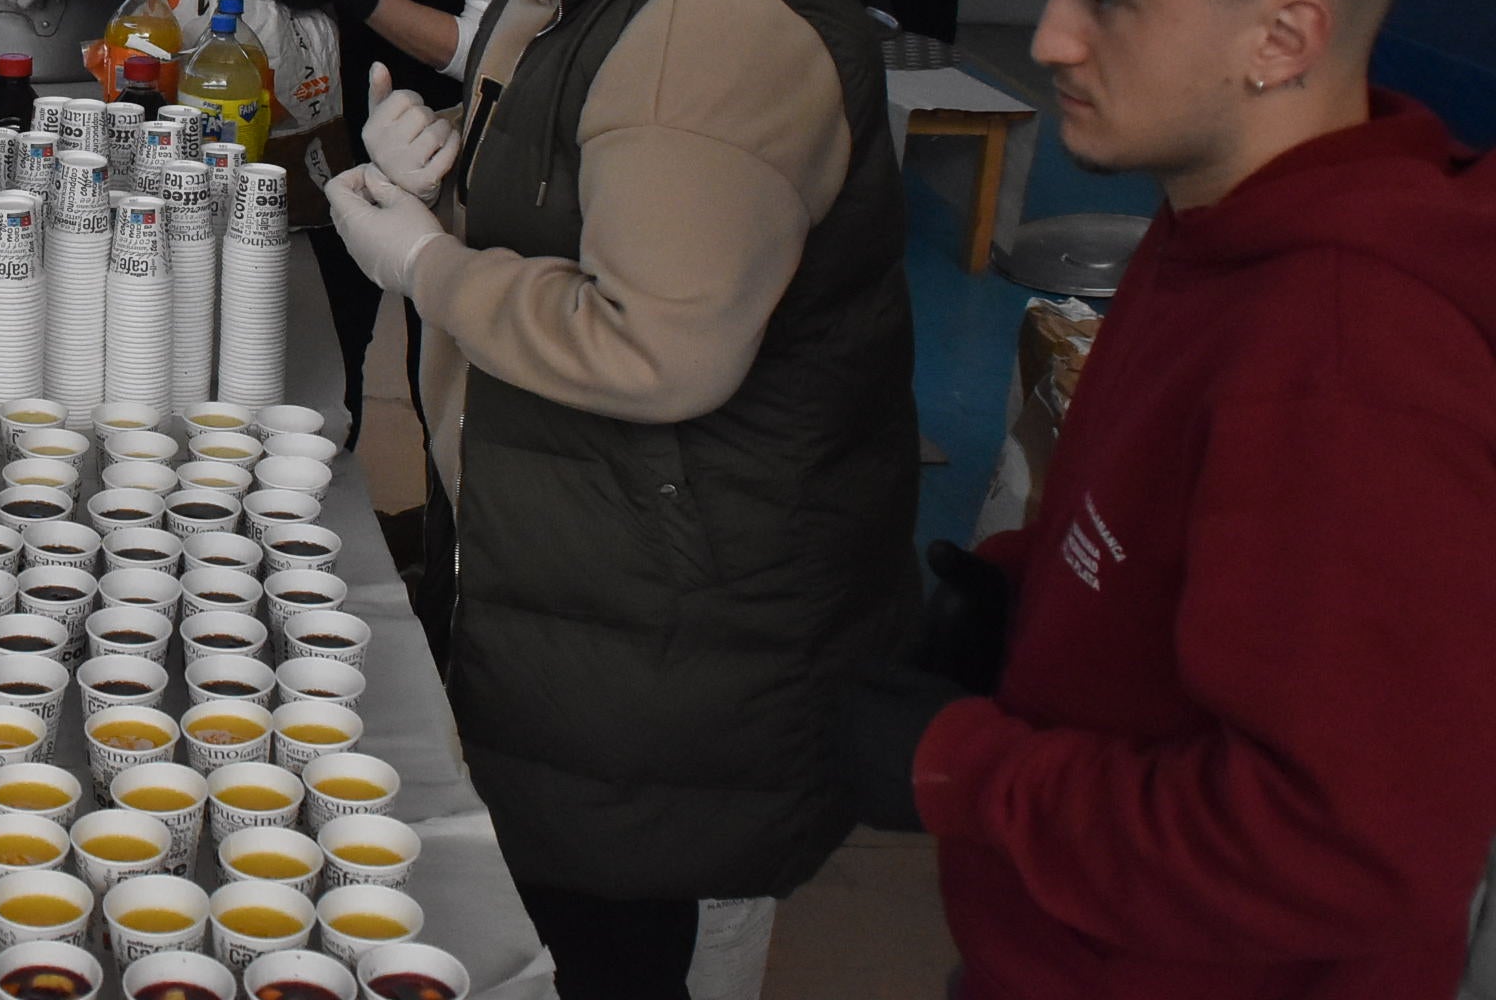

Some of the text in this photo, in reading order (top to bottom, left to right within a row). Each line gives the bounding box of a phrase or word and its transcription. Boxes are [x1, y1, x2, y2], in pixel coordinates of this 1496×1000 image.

[188, 115, 199, 159] coffee
[66, 167, 78, 213] cappuccino
[78, 168, 89, 197] coffee
[165, 173, 183, 190] tea
[257, 178, 278, 193] tea
[234, 174, 250, 221] coffee
[82, 215, 108, 233] cafe
[119, 207, 128, 236] coffee
[120, 256, 149, 275] cafe
[286, 744, 315, 758] latte
[127, 939, 154, 950] coffee
[230, 942, 259, 954] coffee
